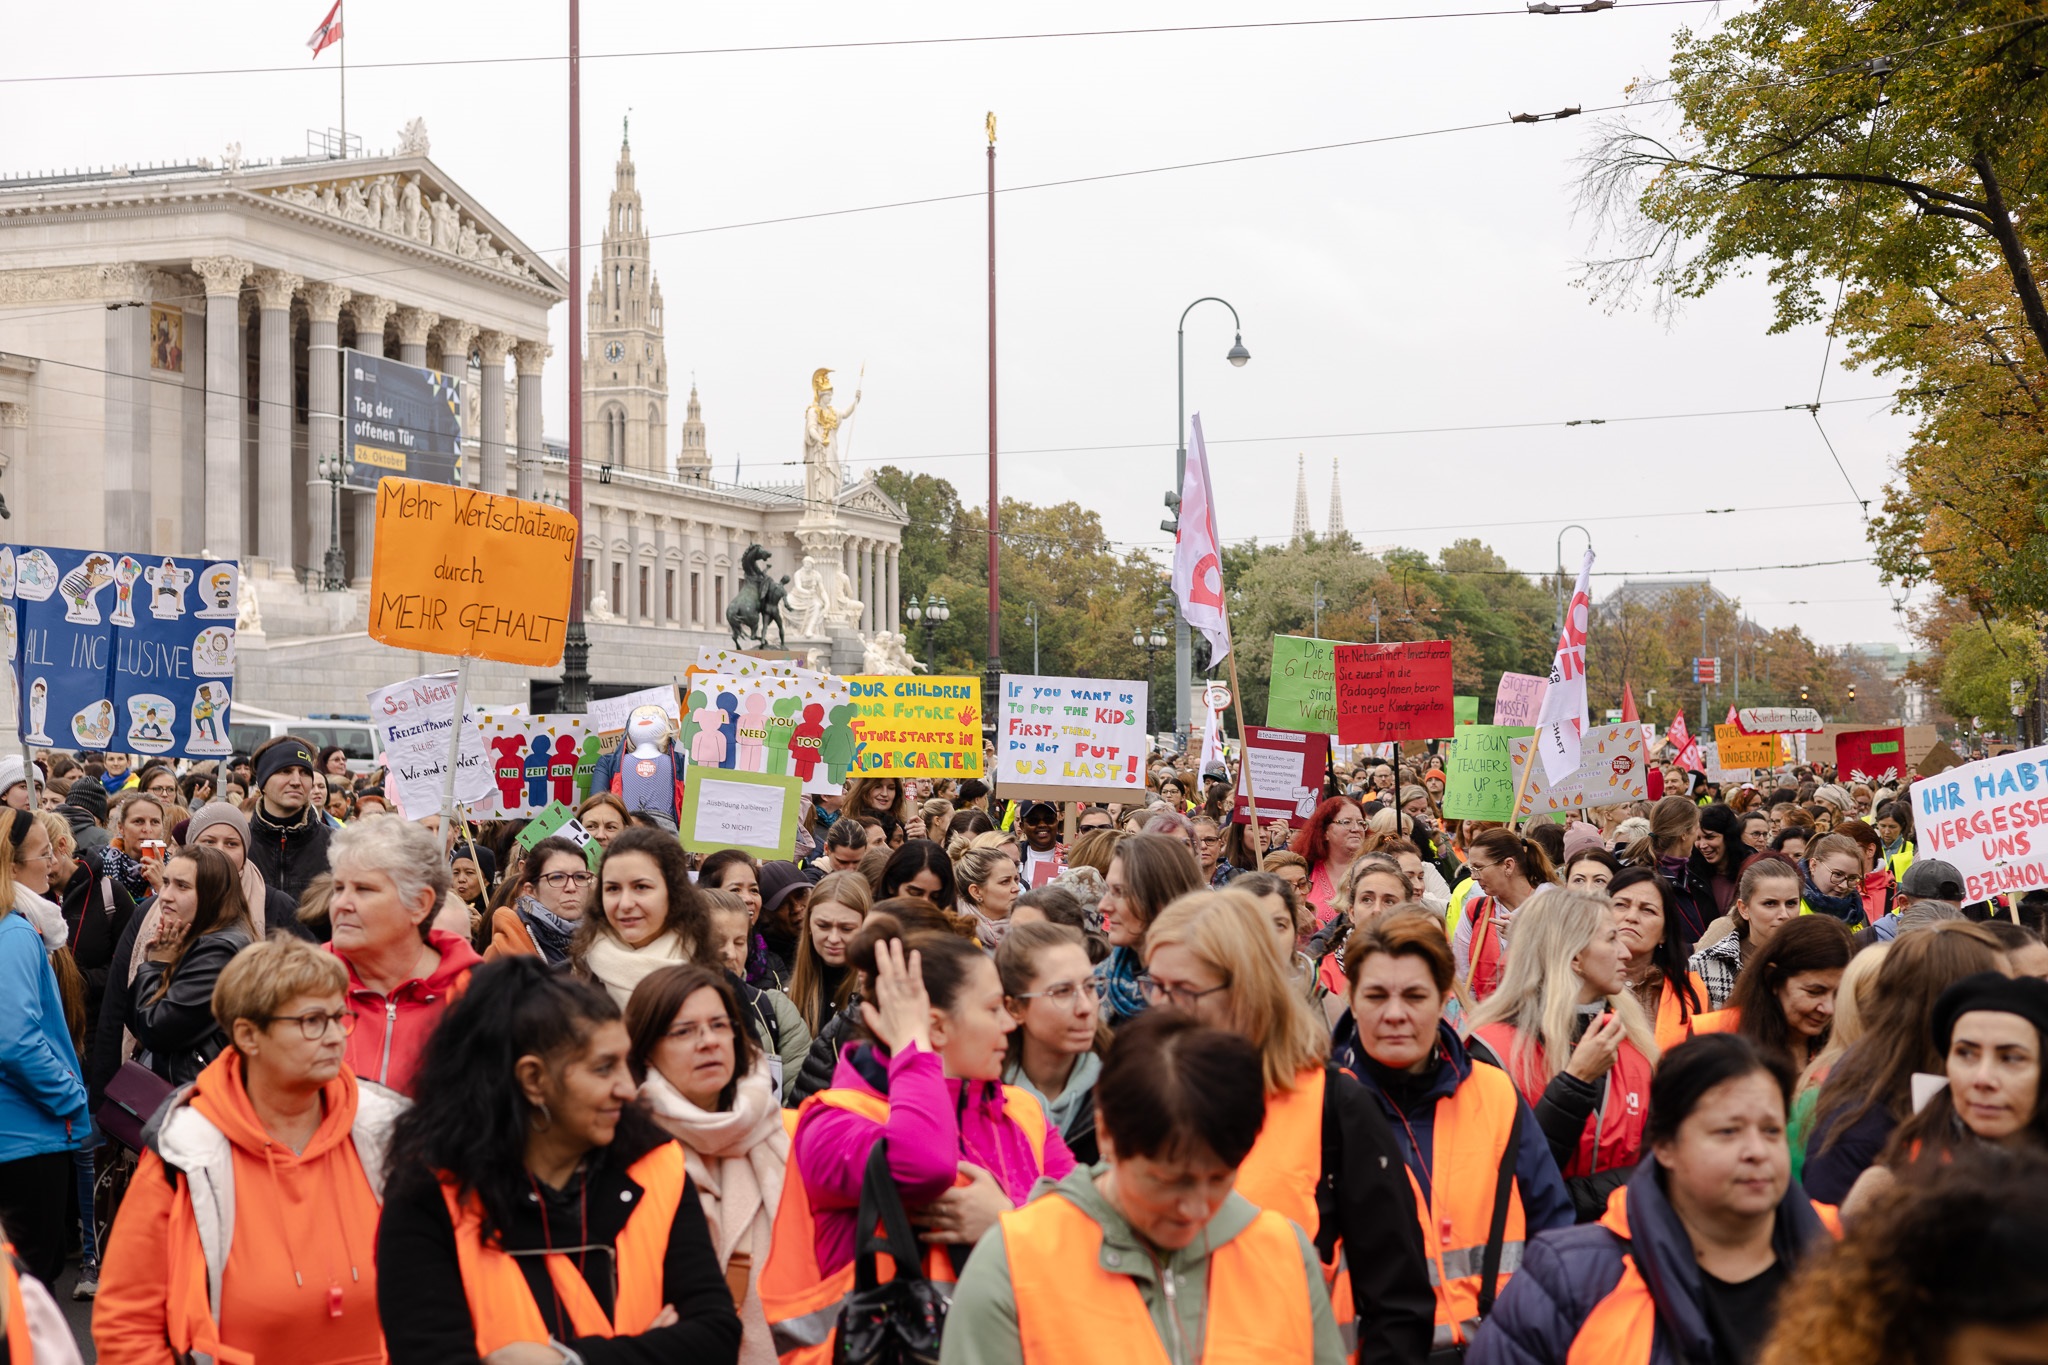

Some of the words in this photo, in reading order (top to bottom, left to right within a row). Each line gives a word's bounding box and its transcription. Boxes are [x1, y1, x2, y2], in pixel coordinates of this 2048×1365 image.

[354, 396, 373, 418] Tag
[376, 401, 393, 419] der
[354, 421, 395, 443] offenen
[397, 429, 415, 446] Tür
[358, 448, 371, 460] 26.
[372, 452, 404, 467] Oktober
[382, 482, 442, 520] Mehr
[453, 488, 576, 562] Wertschätzung
[434, 554, 484, 583] durch
[378, 592, 448, 631] MEHR
[459, 603, 565, 643] GEHALT
[24, 629, 54, 665] ALL
[1304, 641, 1324, 659] Die
[1407, 645, 1449, 660] Investieren
[1285, 659, 1298, 677] 6
[1304, 662, 1335, 681] Leben
[1339, 667, 1353, 680] Sie
[1355, 666, 1384, 679] zuerst
[1387, 669, 1395, 678] in
[1397, 666, 1411, 678] die
[850, 682, 888, 697] OUR
[1008, 682, 1023, 697] IF
[1071, 689, 1111, 701] WANT
[1119, 693, 1133, 704] US
[1414, 682, 1440, 695] bevor
[1502, 675, 1542, 695] STOPPT
[1309, 687, 1331, 701] sind
[893, 703, 954, 720] FUTURE
[1008, 702, 1024, 714] TO
[1031, 704, 1053, 715] PUT
[1064, 706, 1088, 716] THE
[1300, 700, 1338, 726] Wichti
[1341, 700, 1357, 715] Sie
[1361, 704, 1384, 713] neue
[1389, 698, 1443, 715] Kindergärten
[1496, 699, 1529, 718] MASSEN
[1379, 717, 1411, 730] bauen
[1748, 709, 1785, 723] Kinder
[1790, 709, 1817, 722] Rechte
[740, 728, 767, 739] NEED
[770, 717, 794, 727] YOU
[797, 737, 822, 748] TOO
[850, 721, 896, 742] FUTURE
[899, 731, 954, 744] STARTS
[1062, 726, 1097, 739] THEN,
[1258, 730, 1306, 742] #teamnikolaus
[1717, 727, 1741, 739] OVER
[1075, 743, 1119, 760] PUT
[1463, 734, 1470, 750] I
[1477, 734, 1510, 753] FOUN
[1457, 759, 1508, 772] TEACHERS
[1721, 751, 1776, 764] UNDERPAID
[401, 765, 420, 780] Wir
[424, 761, 440, 776] sind
[500, 769, 518, 777] NIE
[527, 768, 547, 776] ZEIT
[552, 766, 572, 775] FÜR
[578, 765, 596, 774] MIC
[1015, 759, 1047, 775] US
[1576, 771, 1601, 779] SYSTEM
[1474, 777, 1490, 792] UP
[1545, 784, 1583, 794] ZUSAMMEN
[706, 800, 740, 809] Ausbildung
[740, 803, 773, 812] halbieren?
[1922, 782, 1966, 815] IHR
[1926, 797, 2048, 852] VERGESSE
[1982, 830, 2031, 861] UNS
[1962, 862, 2048, 903] BZUHOL
